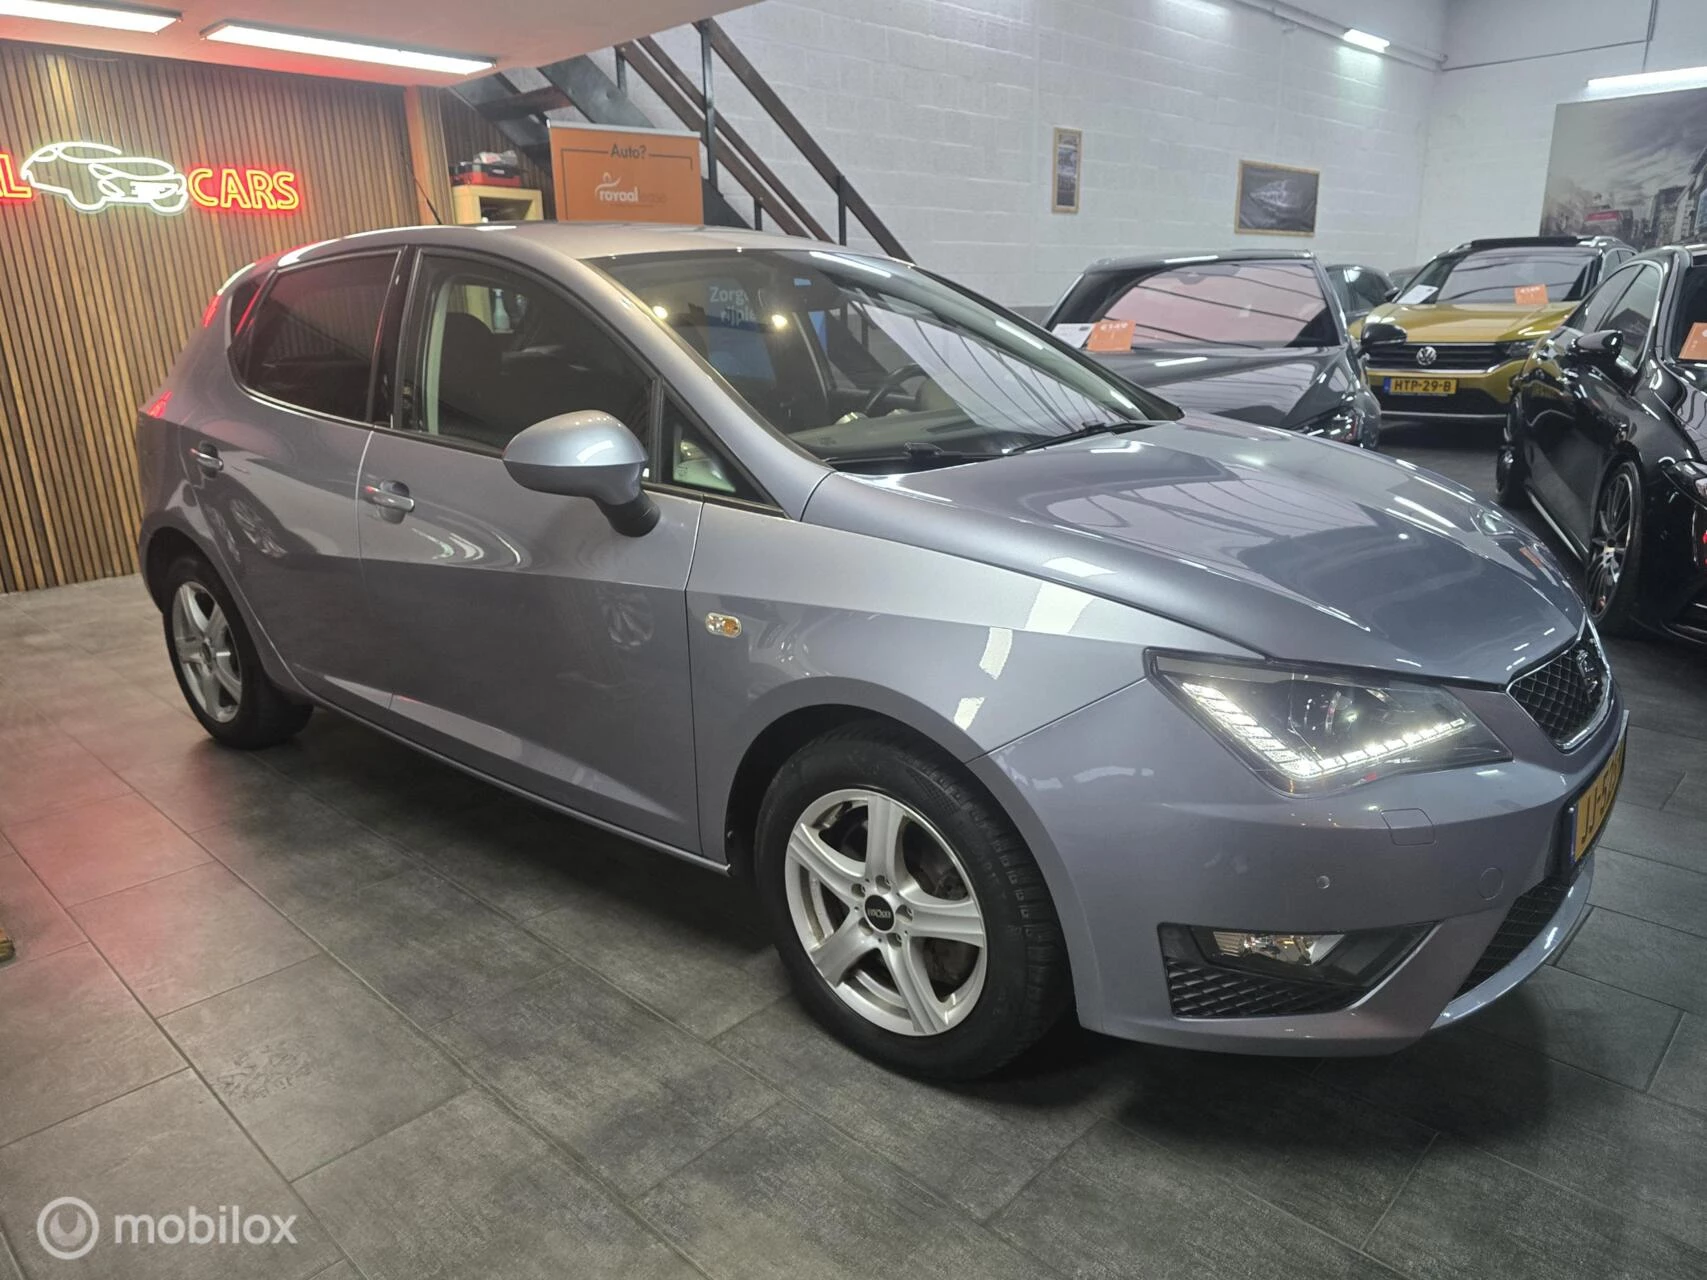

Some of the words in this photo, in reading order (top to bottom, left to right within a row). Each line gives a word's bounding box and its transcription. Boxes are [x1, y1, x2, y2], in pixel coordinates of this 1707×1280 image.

[610, 144, 647, 159] Auto?
[0, 153, 32, 198] L
[188, 168, 299, 210] CARS
[709, 286, 749, 306] Zorg
[1394, 380, 1452, 392] HTP-29-B
